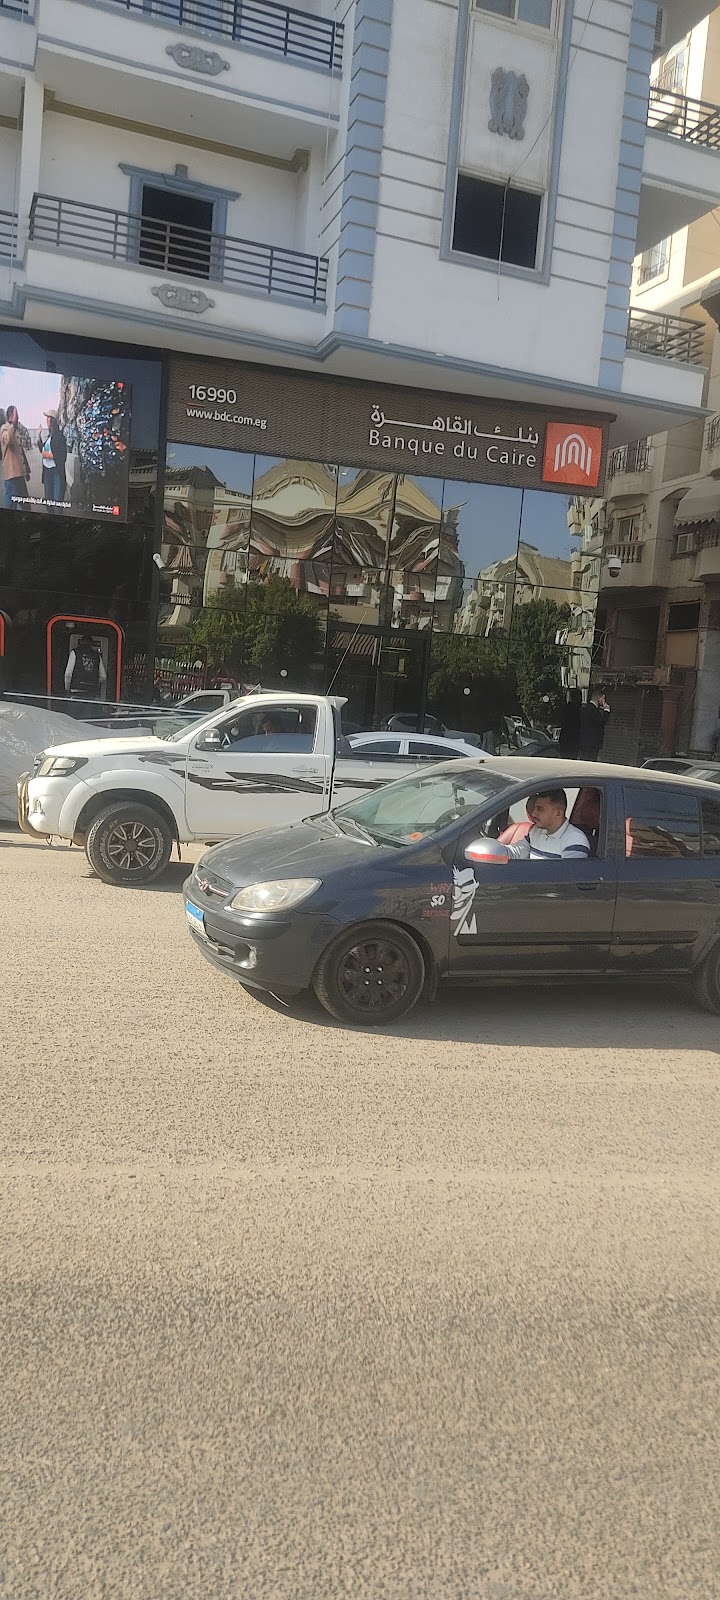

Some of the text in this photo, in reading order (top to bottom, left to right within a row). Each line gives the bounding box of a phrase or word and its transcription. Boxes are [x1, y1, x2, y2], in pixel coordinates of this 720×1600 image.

[188, 384, 237, 404] 16990
[186, 408, 267, 430] www.bdc.com.eg
[370, 404, 540, 448] بنك القاهرة
[368, 429, 537, 468] Banque du Caire
[430, 894, 446, 908] SO
